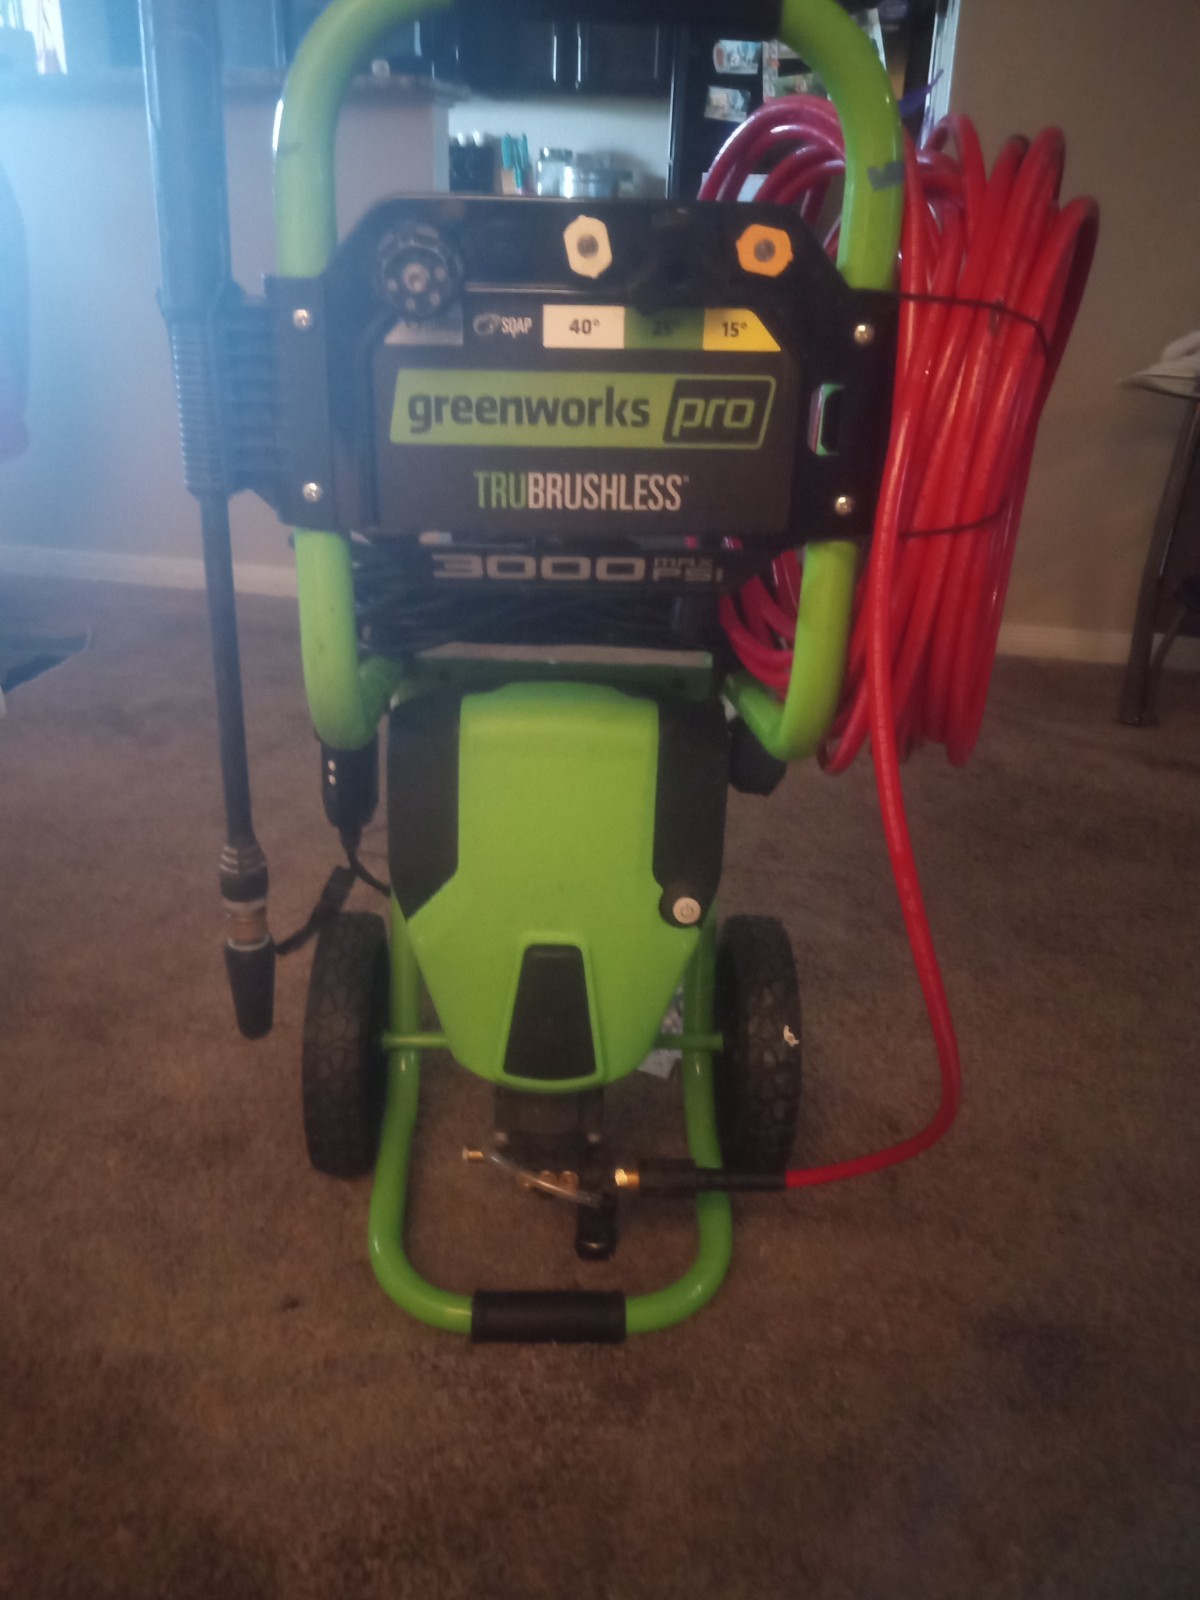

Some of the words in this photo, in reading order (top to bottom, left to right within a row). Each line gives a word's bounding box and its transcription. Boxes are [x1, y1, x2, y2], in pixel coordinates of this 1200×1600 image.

[501, 317, 532, 338] SOAP
[569, 318, 600, 335] 40°
[722, 321, 749, 338] 15°
[408, 386, 650, 434] greenworks
[671, 397, 756, 438] pro
[431, 554, 646, 582] 3000
[653, 567, 724, 582] PSI
